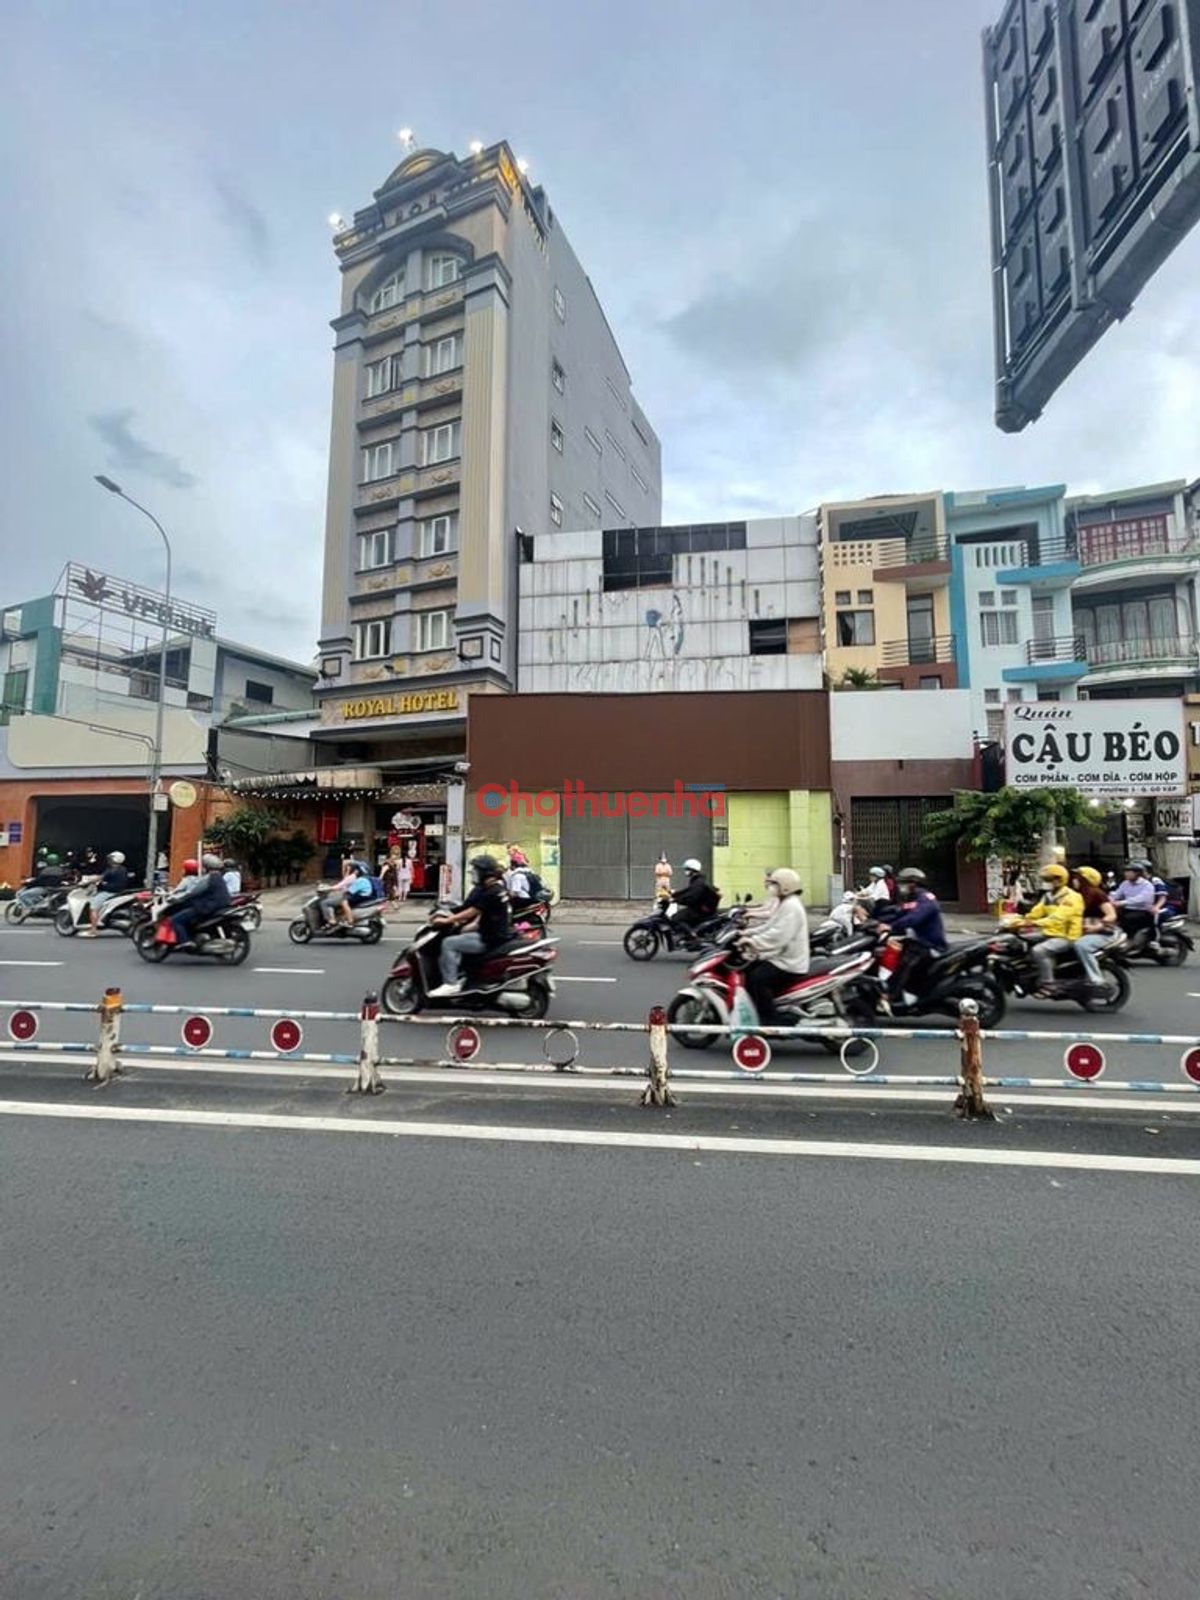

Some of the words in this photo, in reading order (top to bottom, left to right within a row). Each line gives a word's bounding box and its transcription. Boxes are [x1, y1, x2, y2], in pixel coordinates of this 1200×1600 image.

[342, 696, 398, 719] ROYAL
[399, 690, 458, 713] HOTEL
[1012, 723, 1092, 770] CẬU
[1103, 722, 1180, 762] BÉO
